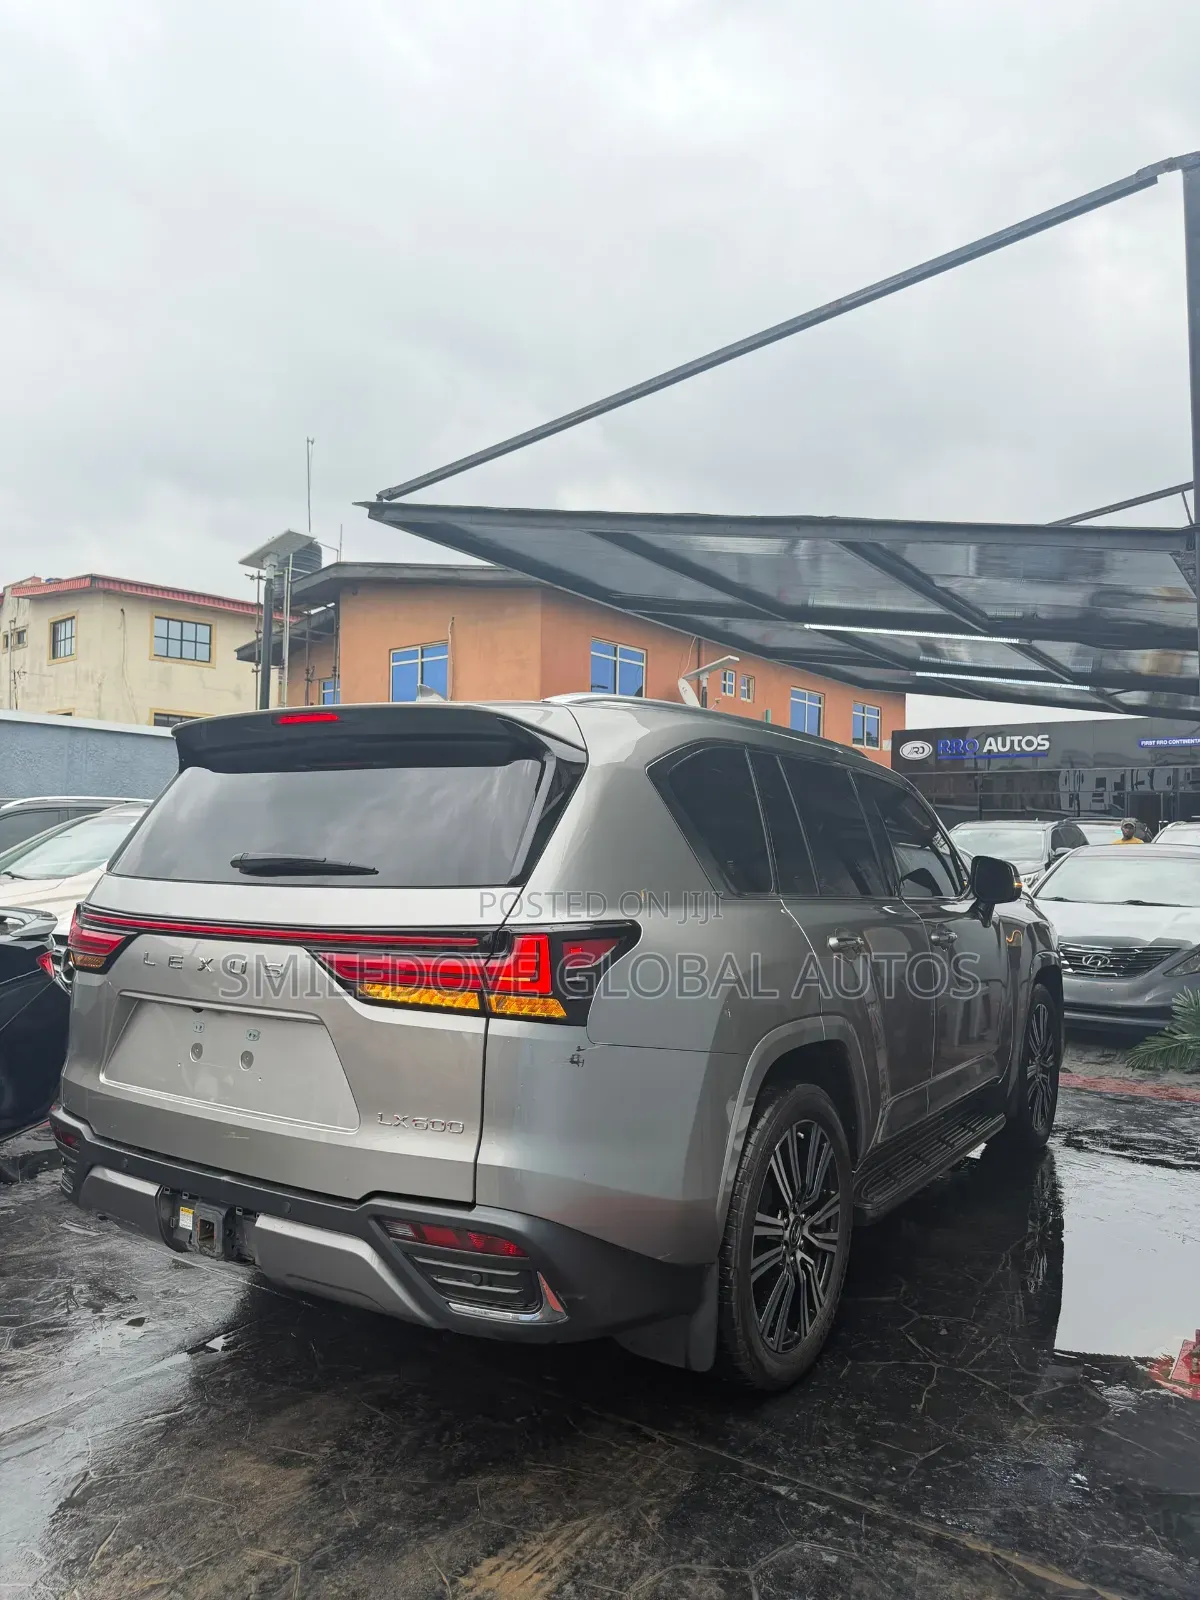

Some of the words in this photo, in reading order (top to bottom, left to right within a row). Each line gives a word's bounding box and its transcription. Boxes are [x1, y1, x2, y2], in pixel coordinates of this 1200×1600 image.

[983, 734, 1050, 753] AUTOS
[143, 951, 284, 979] LEXUS
[377, 1112, 465, 1134] LX600
